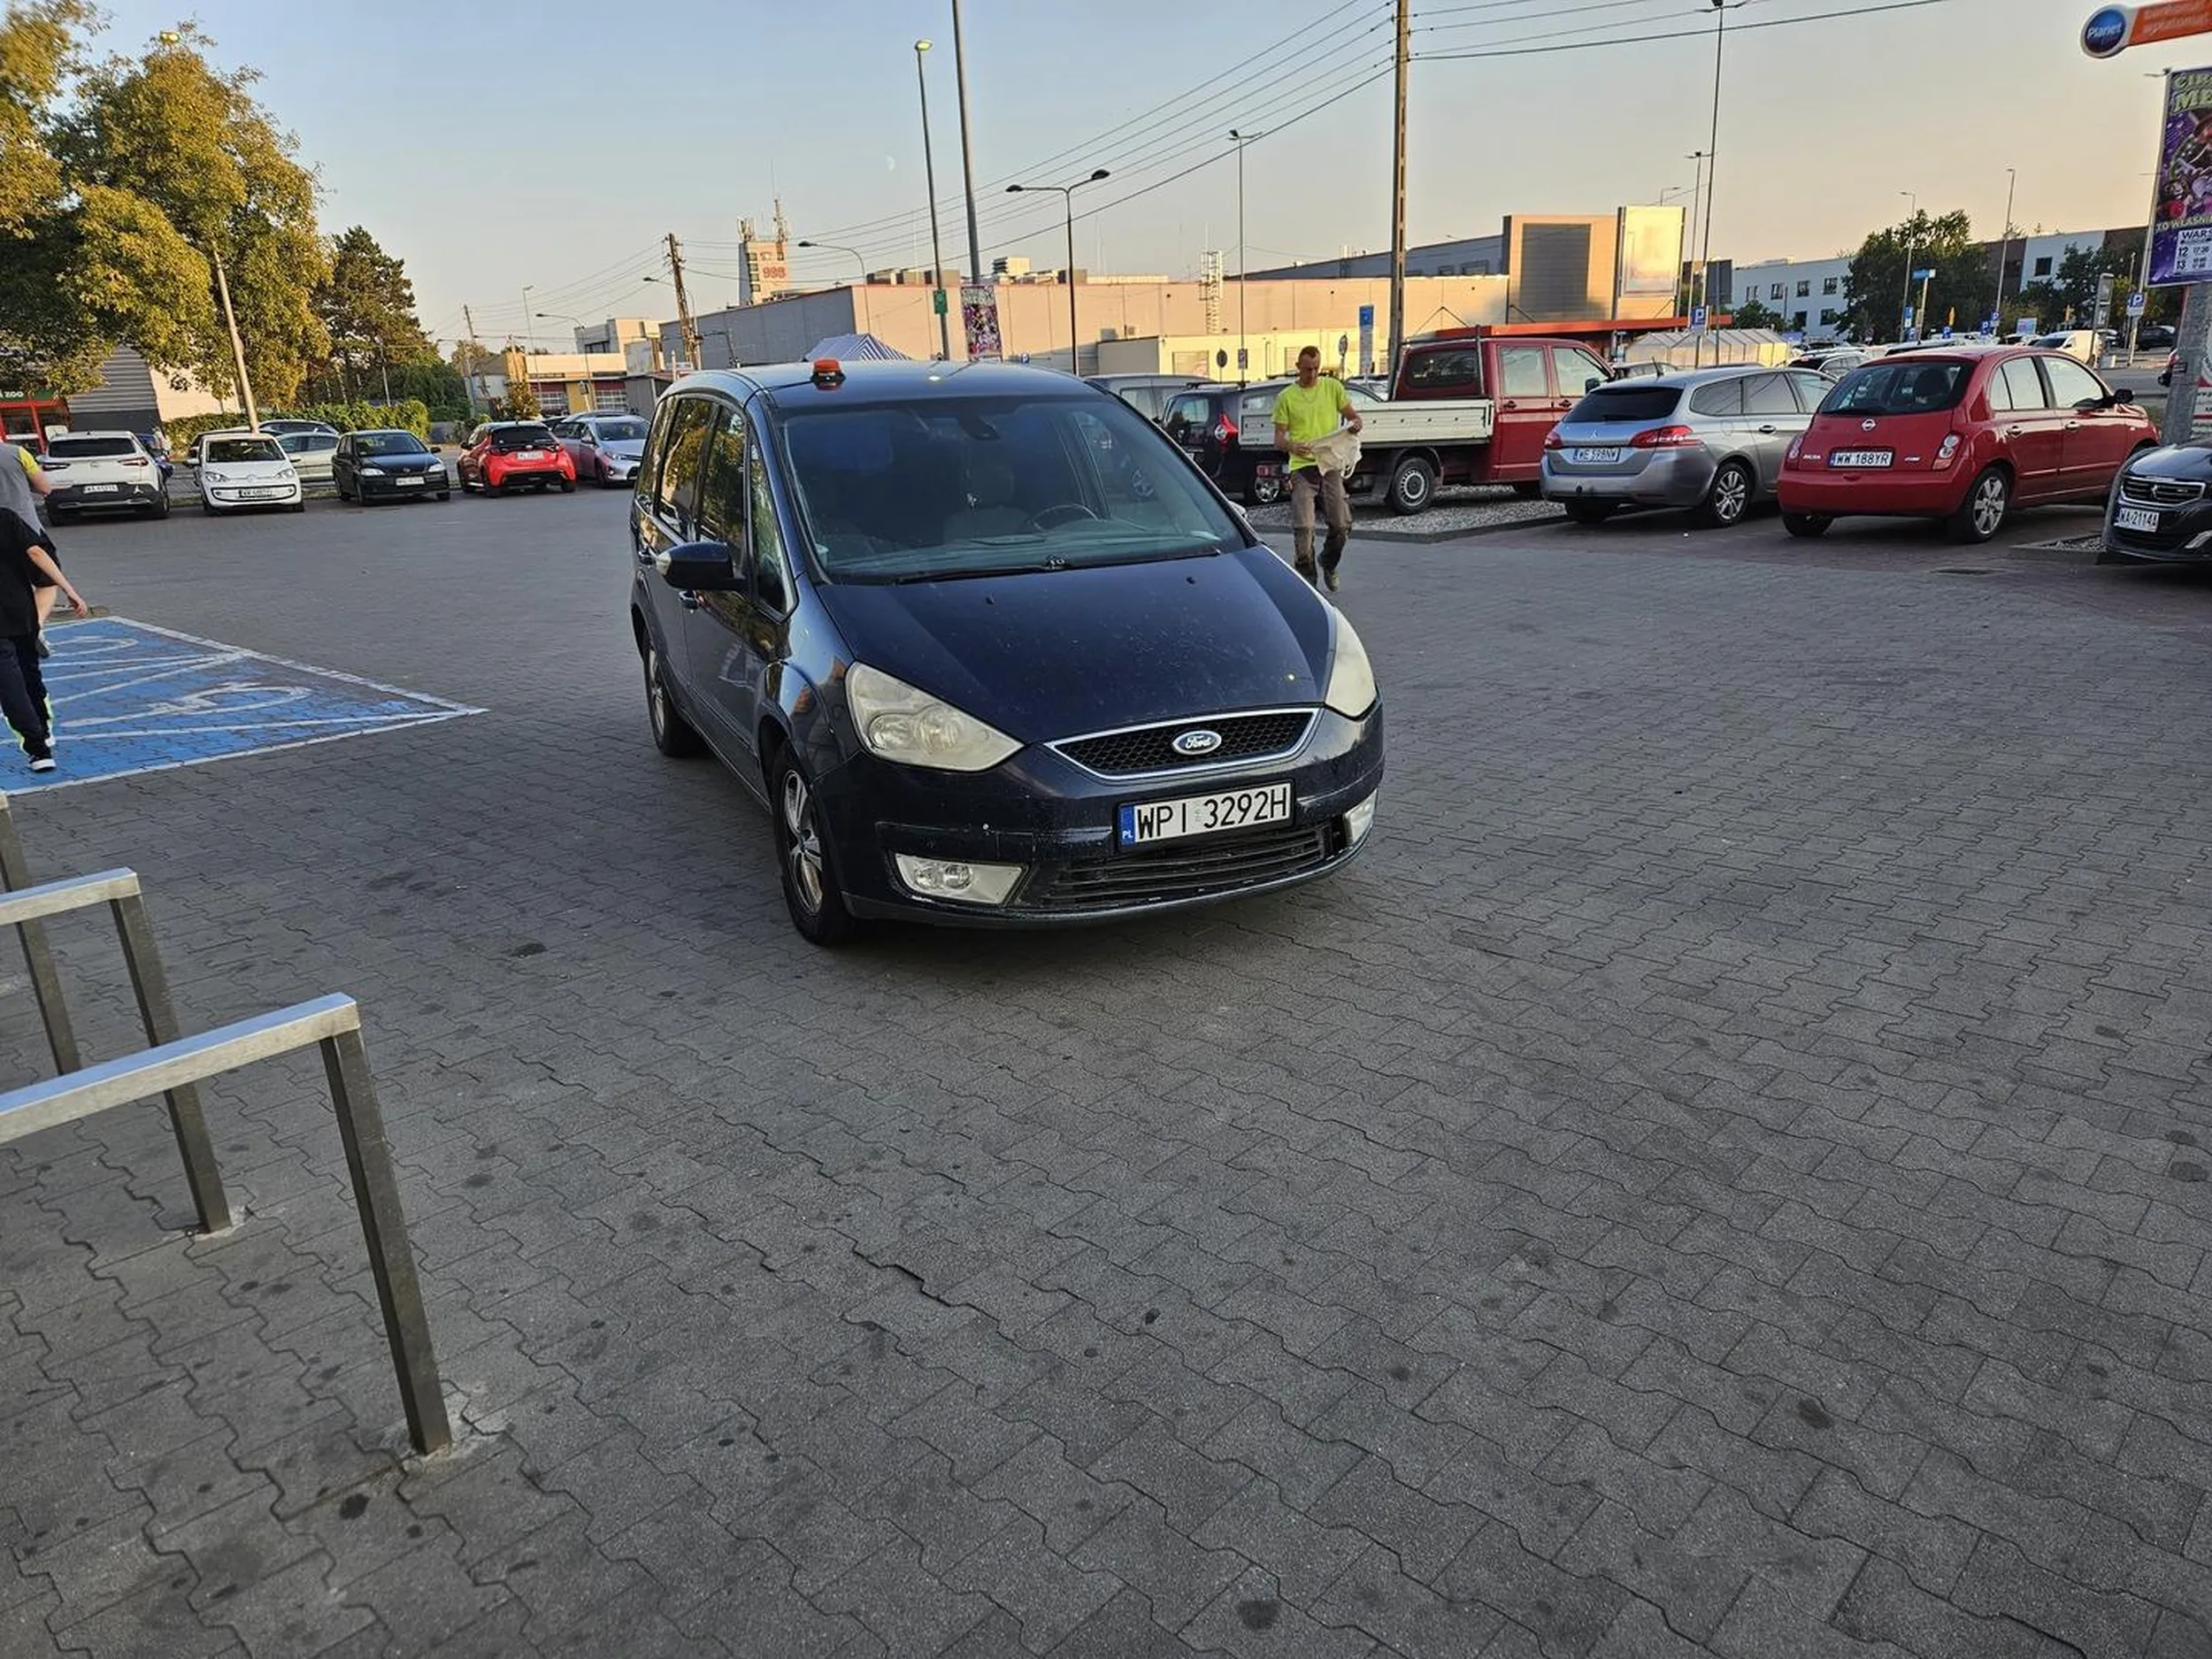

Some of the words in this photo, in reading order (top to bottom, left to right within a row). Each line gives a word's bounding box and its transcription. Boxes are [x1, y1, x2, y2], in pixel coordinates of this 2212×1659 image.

[2087, 23, 2123, 39] Planet
[2178, 247, 2189, 257] 12
[2177, 259, 2187, 270] 13
[763, 266, 787, 279] 998
[1694, 309, 1704, 324] P
[1837, 453, 1851, 465] WW
[1855, 452, 1888, 465] 188YR
[1186, 734, 1211, 749] Ford
[1137, 803, 1187, 840] WPI
[1203, 787, 1288, 829] 3292H
[1122, 830, 1133, 840] PL
